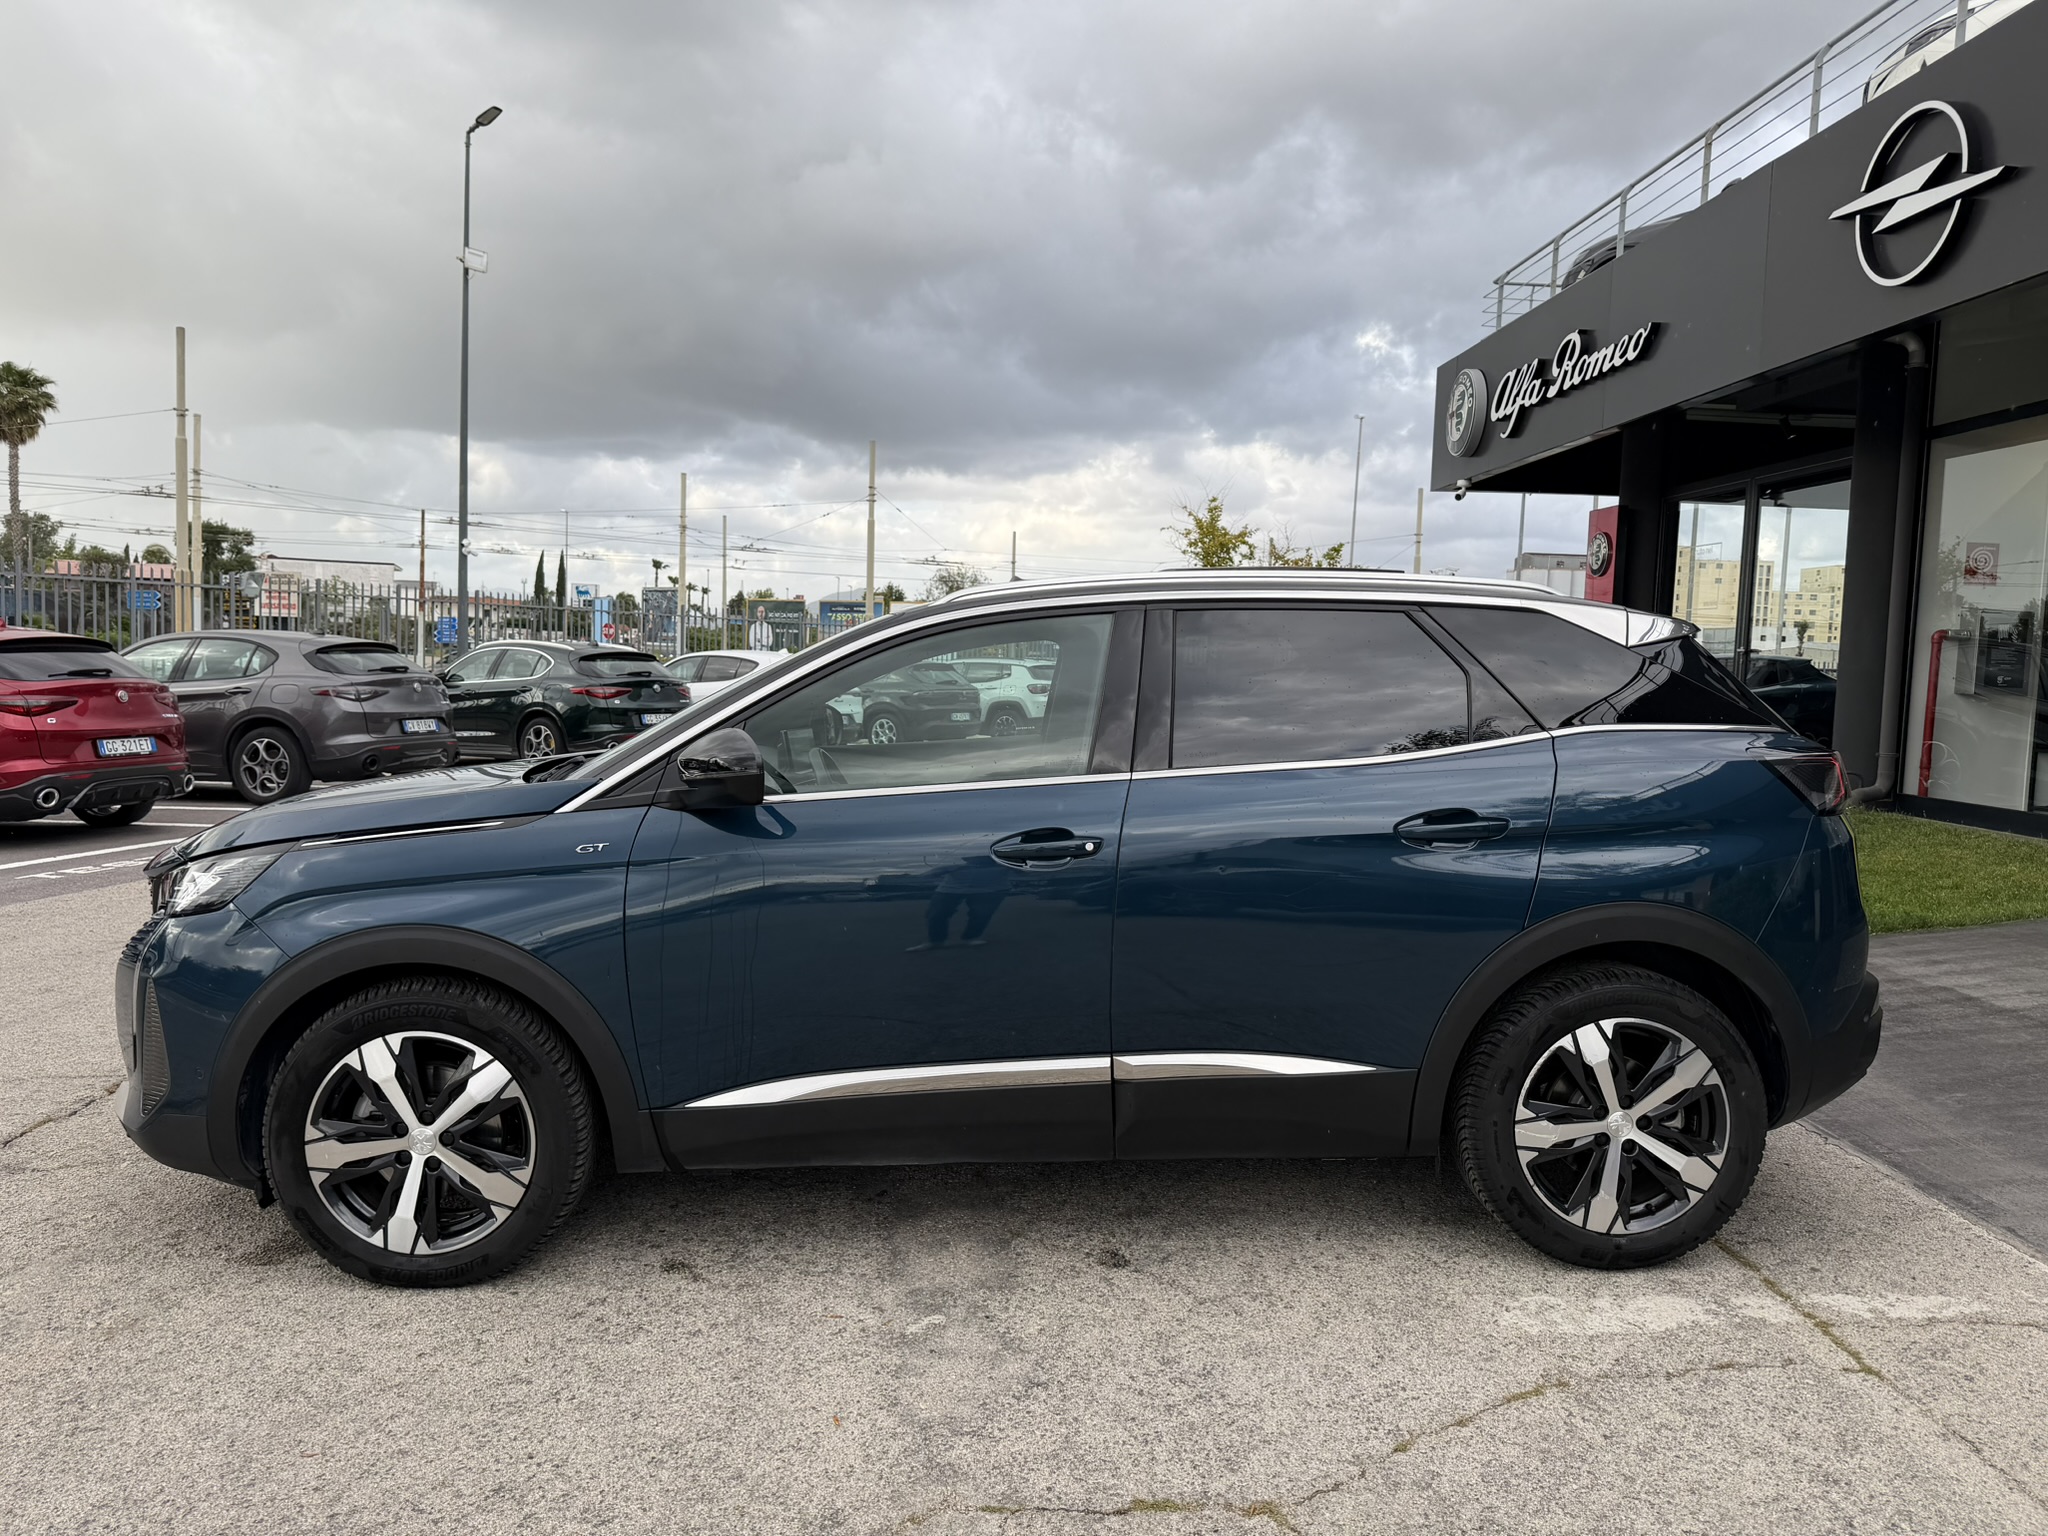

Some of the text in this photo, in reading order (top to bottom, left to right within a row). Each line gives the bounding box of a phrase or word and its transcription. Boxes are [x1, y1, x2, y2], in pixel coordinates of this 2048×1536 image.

[1490, 321, 1652, 439] Alfa Romeo
[105, 738, 150, 753] GG 321ET
[575, 842, 610, 854] GT
[351, 1003, 457, 1030] BRIDGESTONE
